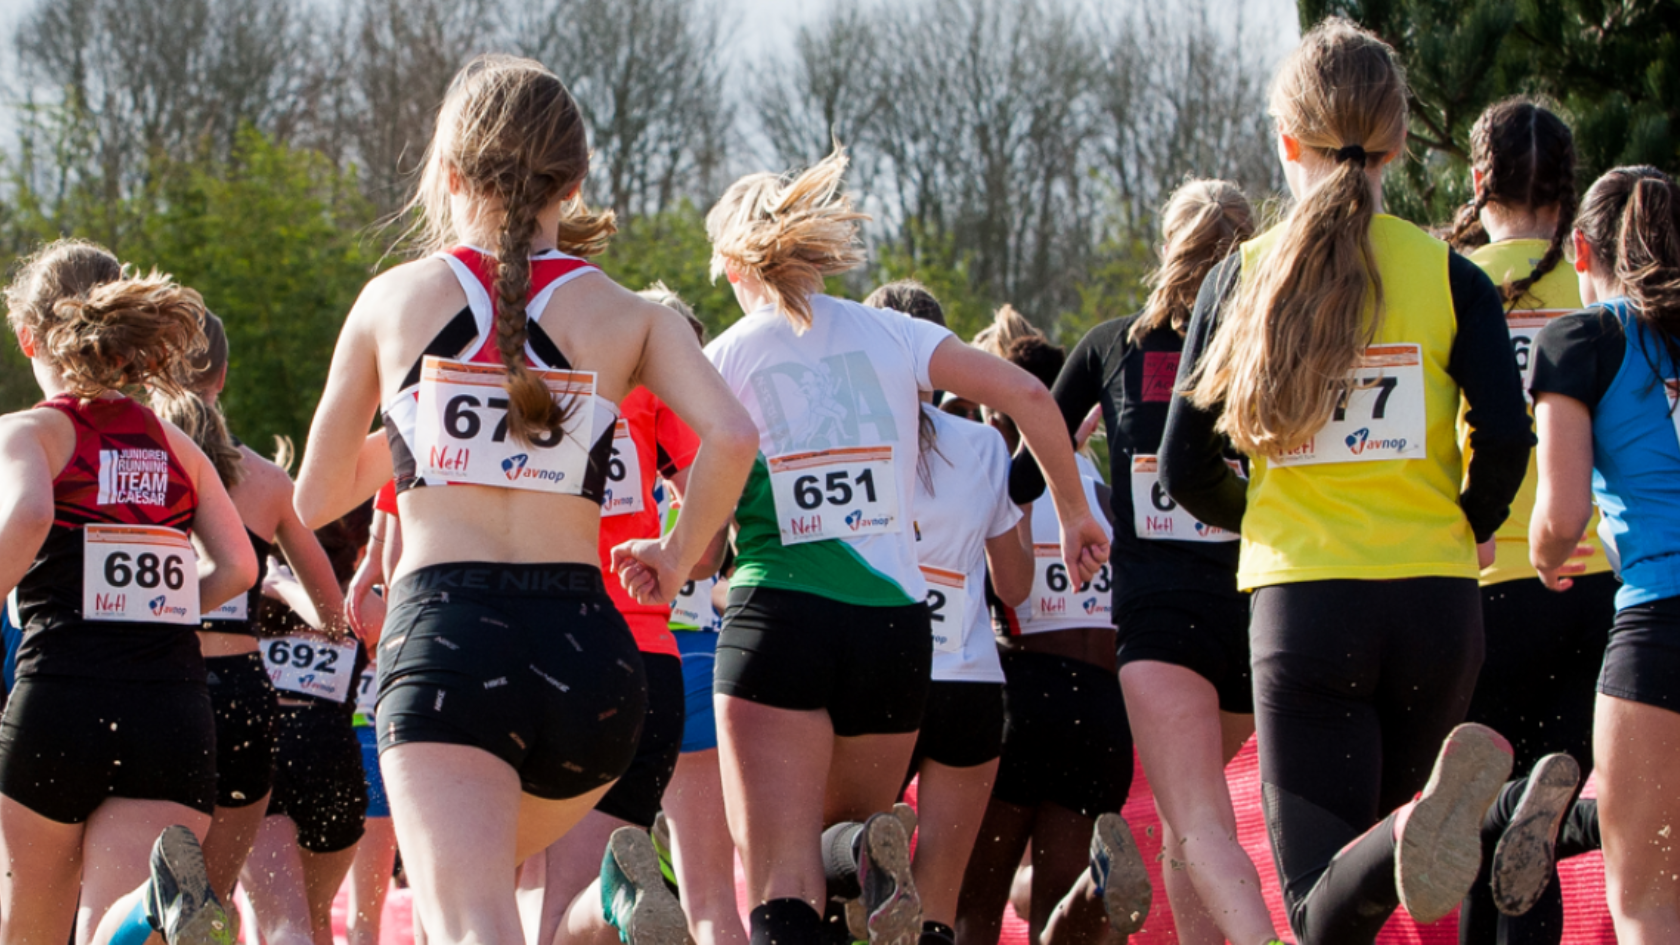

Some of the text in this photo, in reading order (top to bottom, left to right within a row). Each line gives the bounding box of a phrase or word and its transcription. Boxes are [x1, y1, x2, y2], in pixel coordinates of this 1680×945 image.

[119, 448, 168, 461] JUNIOREN
[1366, 438, 1407, 453] avnop
[118, 460, 168, 472] RUNNING
[522, 466, 565, 484] avnop
[118, 472, 168, 493] TEAM
[794, 468, 877, 511] 651
[117, 490, 166, 506] CAESAR
[104, 551, 184, 590] 686
[1046, 563, 1112, 593] 63
[268, 641, 338, 674] 692
